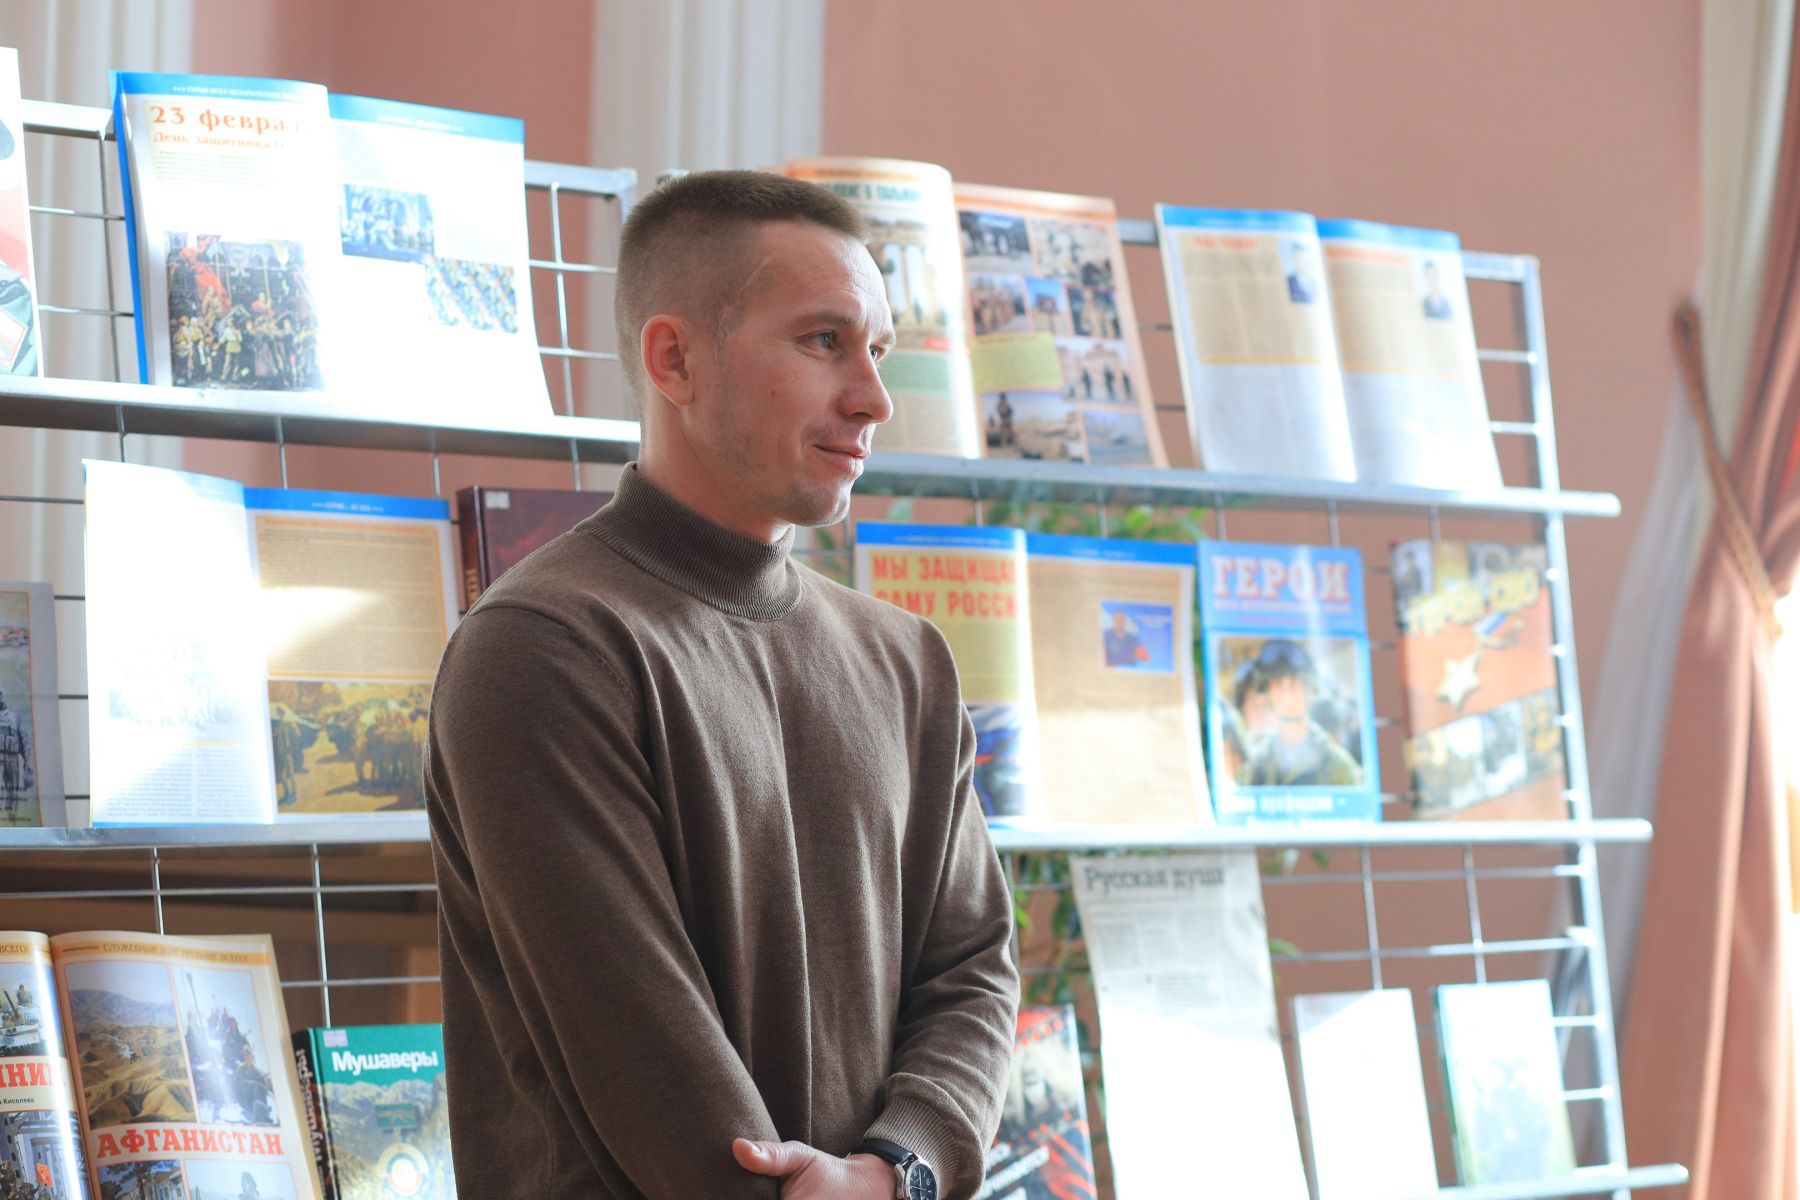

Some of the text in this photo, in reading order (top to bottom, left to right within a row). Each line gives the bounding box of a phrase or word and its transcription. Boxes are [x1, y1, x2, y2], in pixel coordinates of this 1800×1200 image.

[150, 105, 298, 135] 23 февра
[872, 555, 909, 580] МЫ
[1211, 555, 1352, 602] ГЕРОИ
[1084, 865, 1225, 895] Русская душа
[331, 1050, 439, 1076] Мушаверы
[96, 1128, 285, 1159] АФГАНИСТАН
